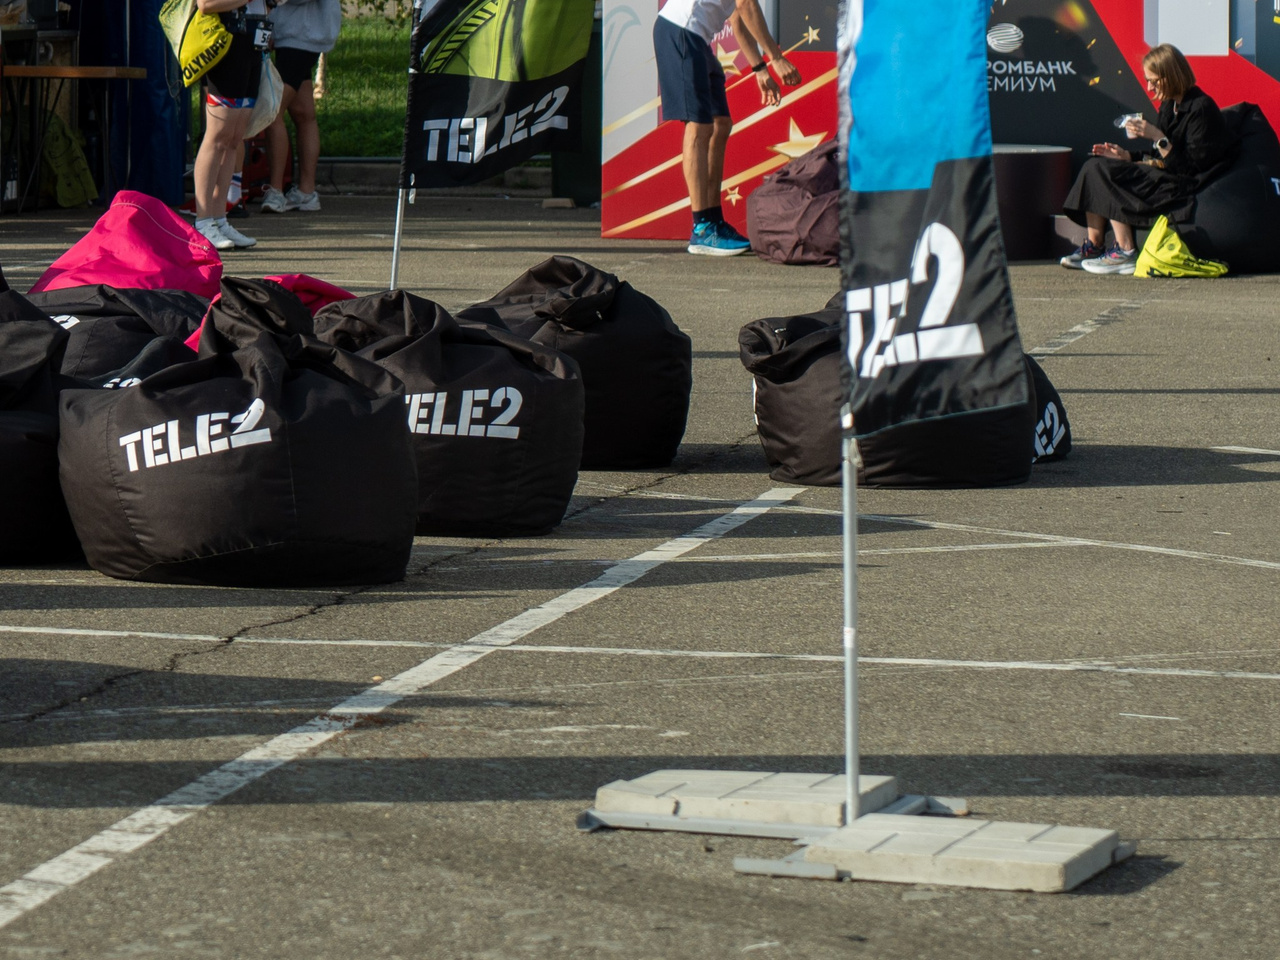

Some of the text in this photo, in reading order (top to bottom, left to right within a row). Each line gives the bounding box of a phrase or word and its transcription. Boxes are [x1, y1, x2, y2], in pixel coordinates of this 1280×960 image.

[423, 85, 569, 163] TELE2
[119, 397, 273, 473] TELE2
[405, 386, 523, 440] ELE2
